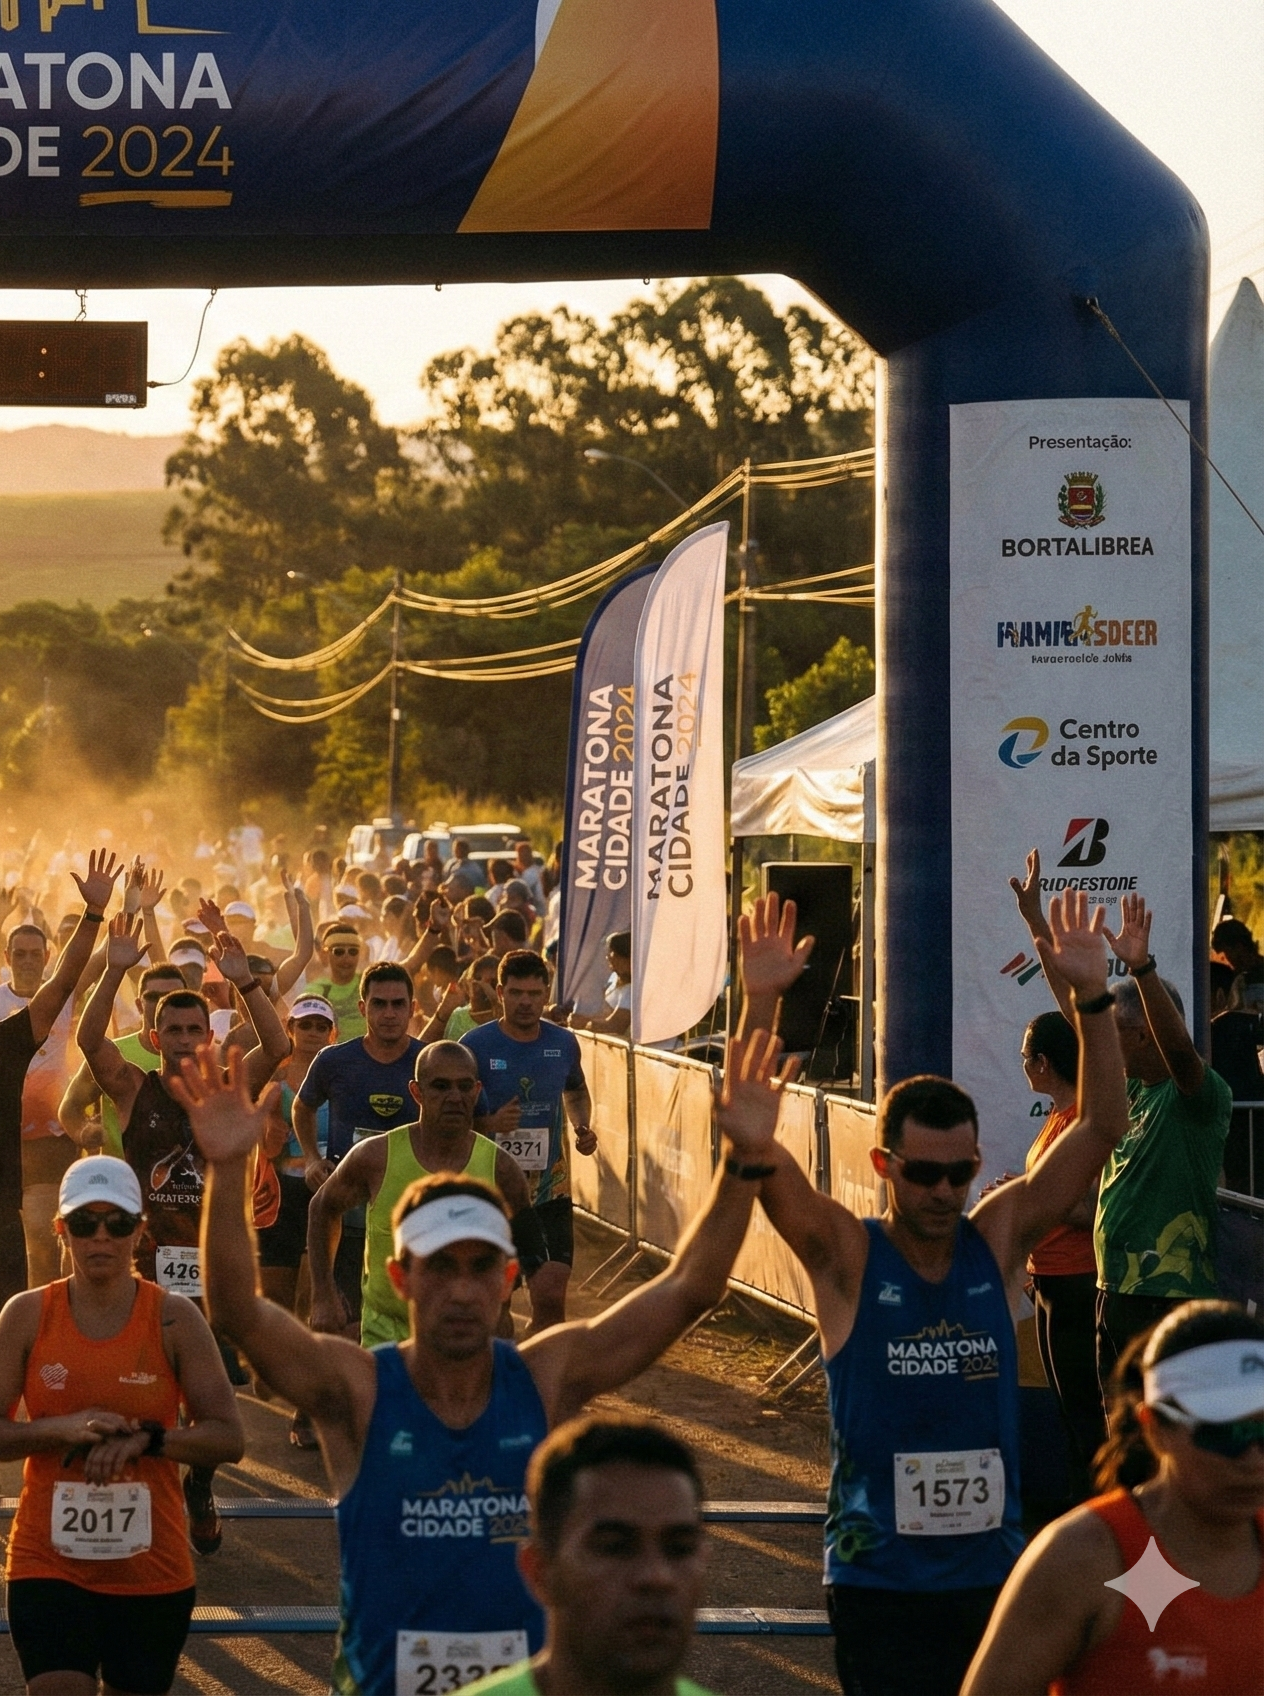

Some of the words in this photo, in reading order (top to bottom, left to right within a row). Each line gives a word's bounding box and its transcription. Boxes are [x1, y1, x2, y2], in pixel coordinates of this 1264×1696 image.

[81, 124, 235, 178] 2024
[1029, 435, 1132, 452] Presentação:
[1001, 537, 1154, 557] BORTALIBREA
[611, 684, 635, 764] 2024
[676, 673, 699, 755] 2024
[1059, 719, 1140, 740] Centro
[1051, 746, 1081, 766] da
[1086, 745, 1158, 771] Sporte
[574, 684, 614, 890] MARATONA
[646, 673, 675, 901] MARATONA
[602, 770, 634, 891] CIDADE
[667, 764, 694, 899] CIDADE
[1038, 876, 1138, 892] RIDGESTONE
[887, 1337, 999, 1359] MARATONA
[887, 1359, 959, 1376] CIDADE
[912, 1476, 990, 1507] 1573
[401, 1494, 533, 1518] MARATONA
[62, 1506, 136, 1533] 2017
[400, 1517, 485, 1539] CIDADE
[488, 1515, 530, 1535] 202
